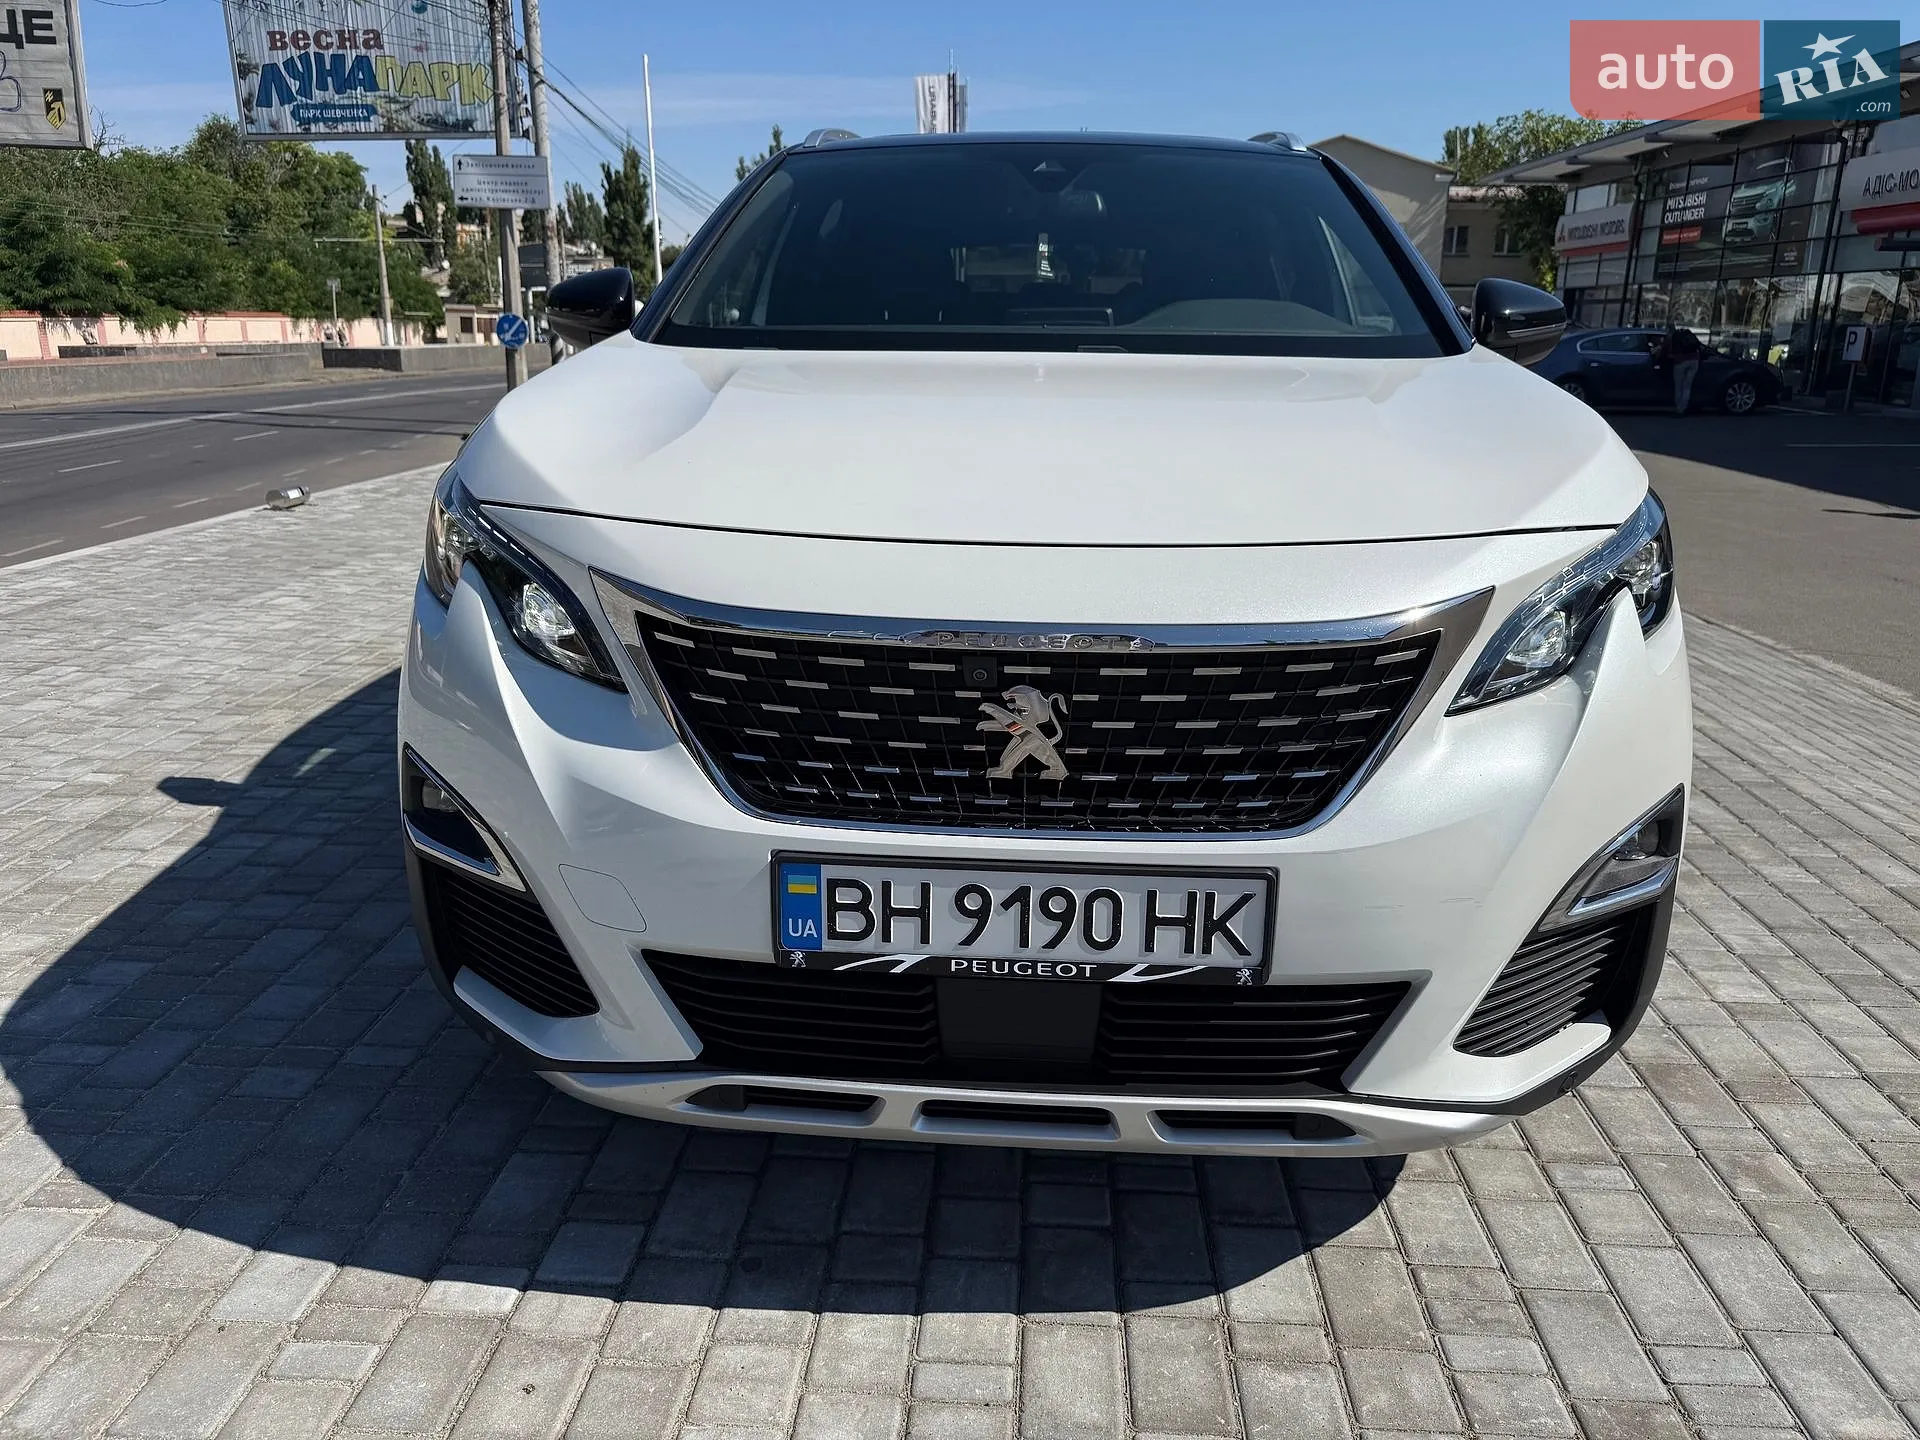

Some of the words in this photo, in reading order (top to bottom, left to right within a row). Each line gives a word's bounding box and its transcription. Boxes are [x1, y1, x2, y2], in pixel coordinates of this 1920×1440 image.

[299, 109, 322, 119] ПАРК
[1846, 330, 1858, 353] P
[954, 882, 1124, 951] 9190
[788, 918, 818, 938] UA
[950, 958, 1098, 978] PEUGEOT
